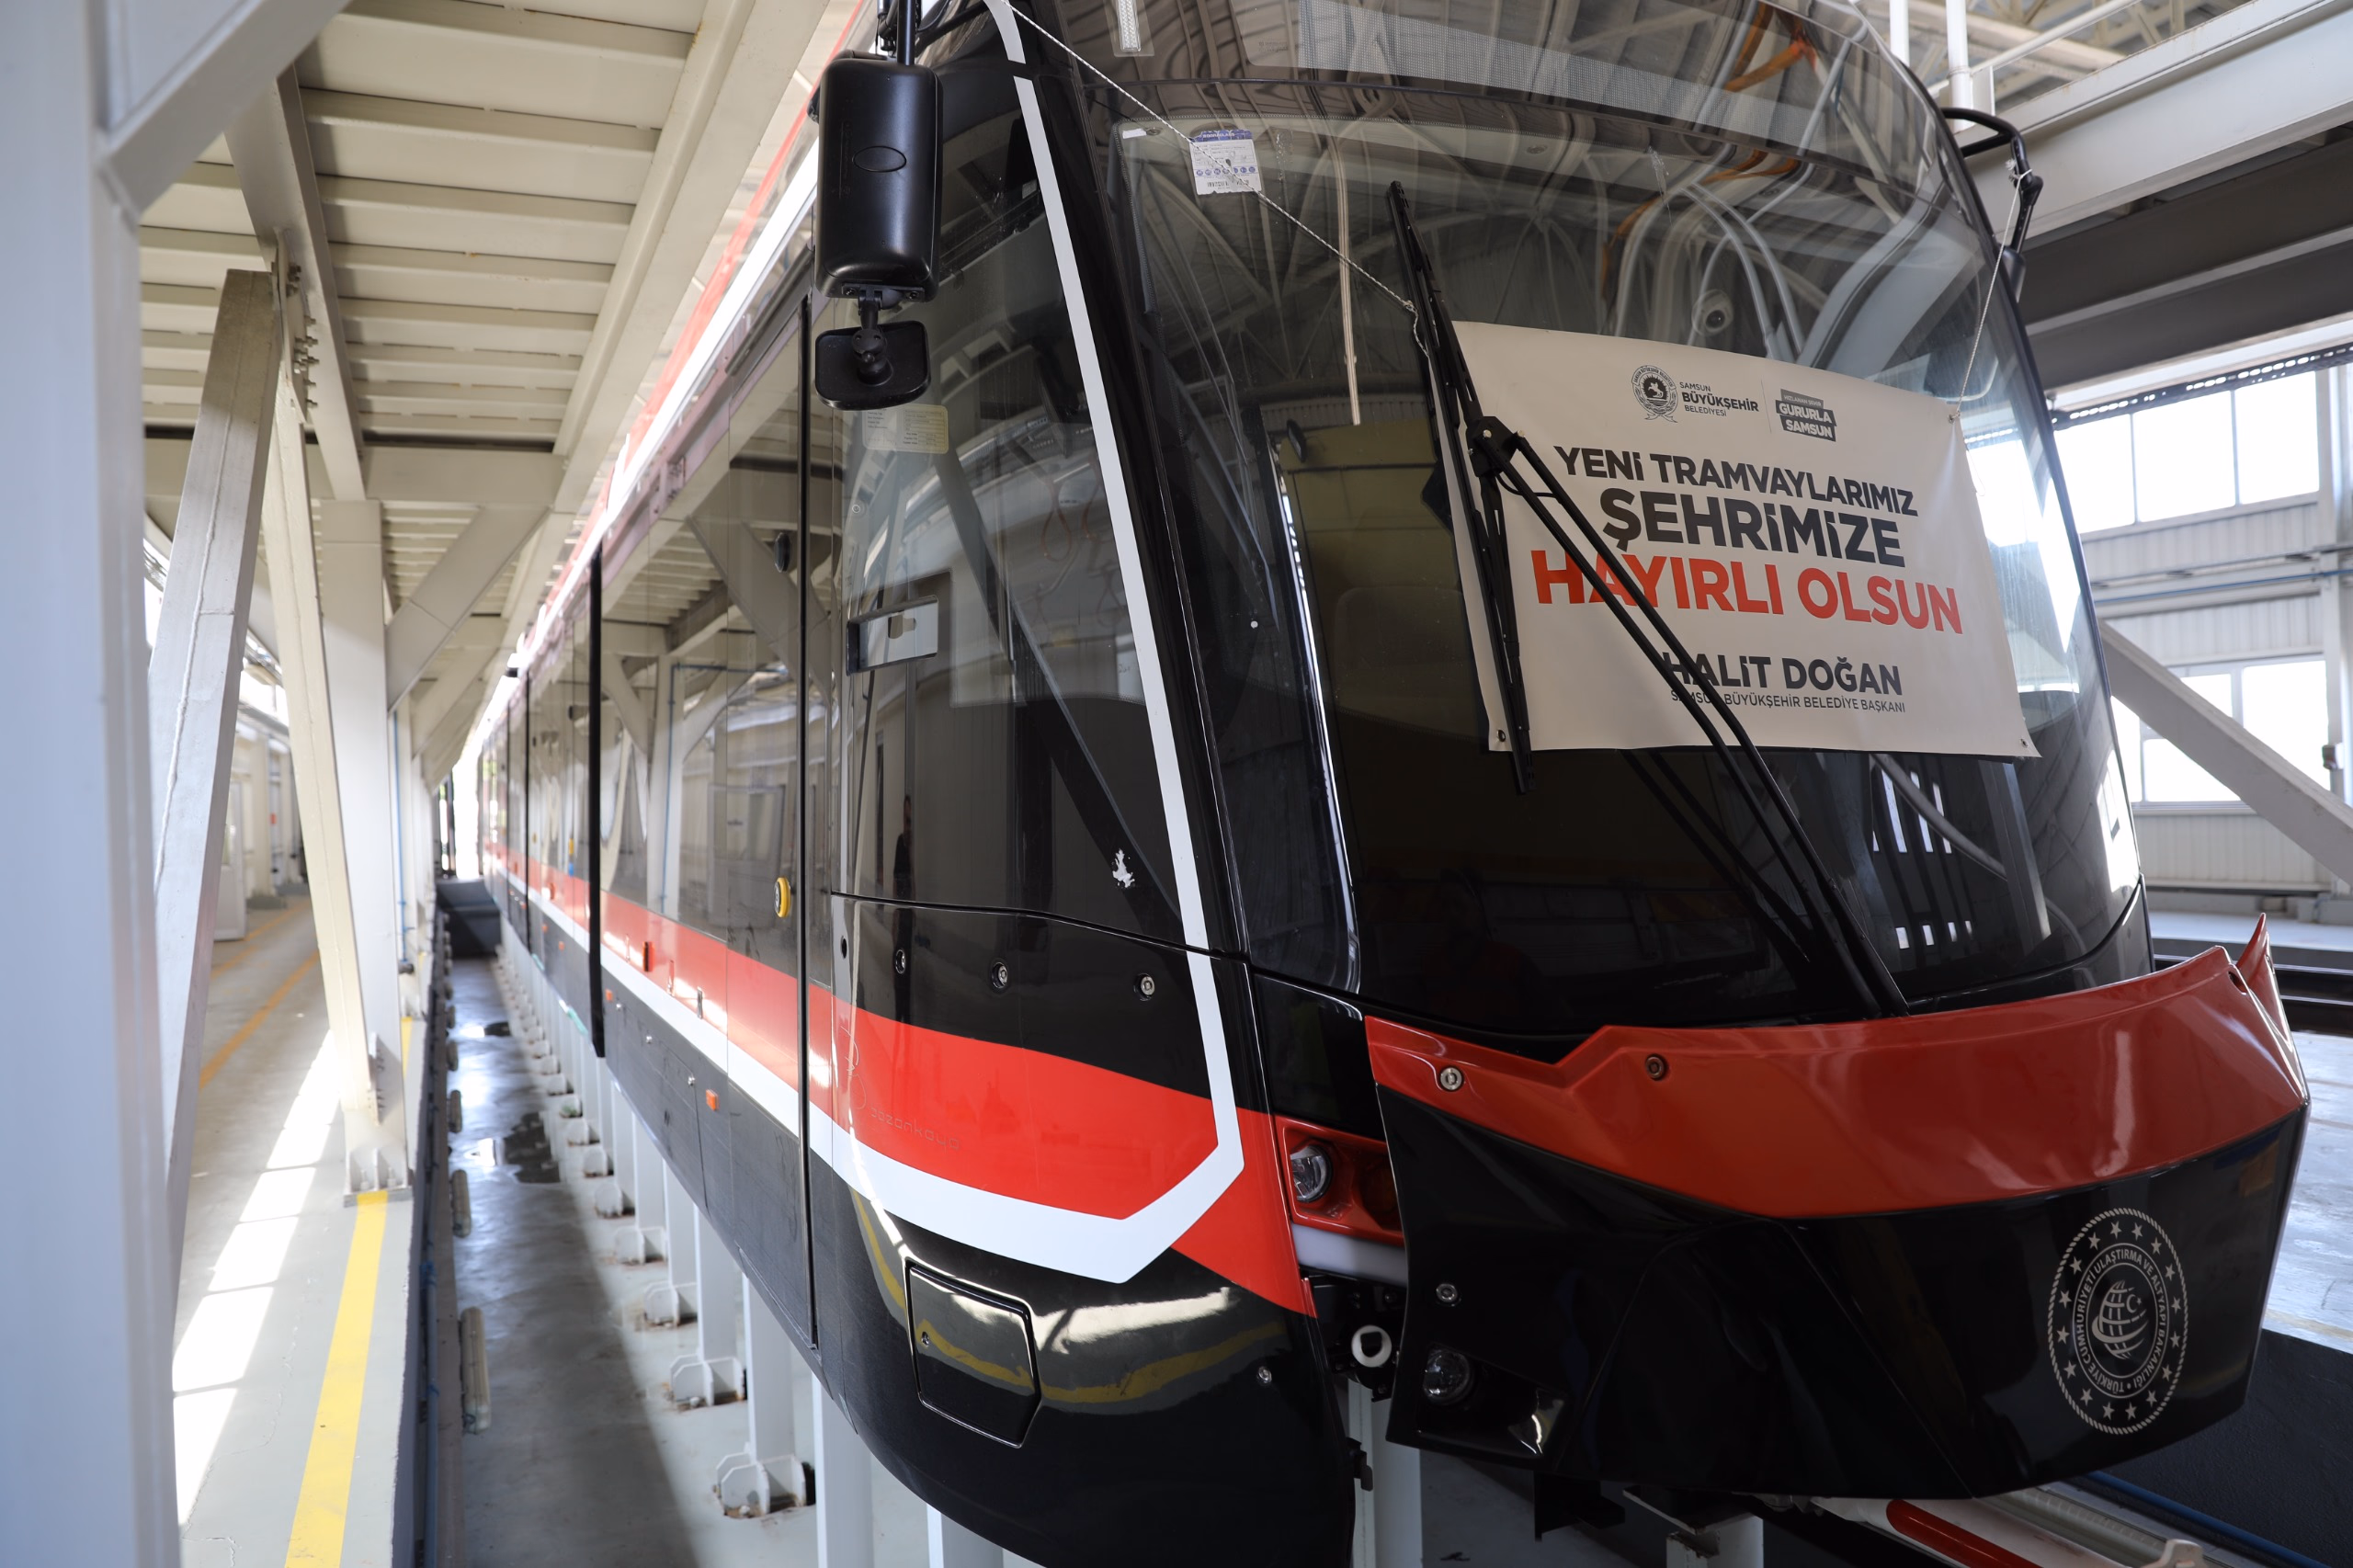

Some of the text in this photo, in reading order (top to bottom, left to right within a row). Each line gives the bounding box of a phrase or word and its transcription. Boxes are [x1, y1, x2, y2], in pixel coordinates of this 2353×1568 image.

[1679, 381, 1711, 392] SAMSUN
[1681, 391, 1759, 412] BÜYÜKŞEHİR
[1684, 404, 1727, 416] BELEDİYESİ
[1779, 403, 1833, 424] GURURLA
[1785, 419, 1833, 438] SAMSUN
[1553, 445, 1918, 517] YENİ TRAMVAYLARIMIZ
[1599, 487, 1905, 568] ŞEHRİMİZE
[1530, 550, 1963, 634] HAYIRLI OLSUN
[1662, 652, 1903, 696] HALİT DOĞAN
[1724, 692, 1801, 709] BÜYÜKŞEHİR
[1804, 696, 1859, 710] BELEDİYE
[1861, 700, 1905, 713] BAŞKANI
[2075, 1248, 2166, 1393] TÜRKİYE CUMHURİYETİ ULAŞTIRMA VE ALTYAPI BAKANLIĞI
